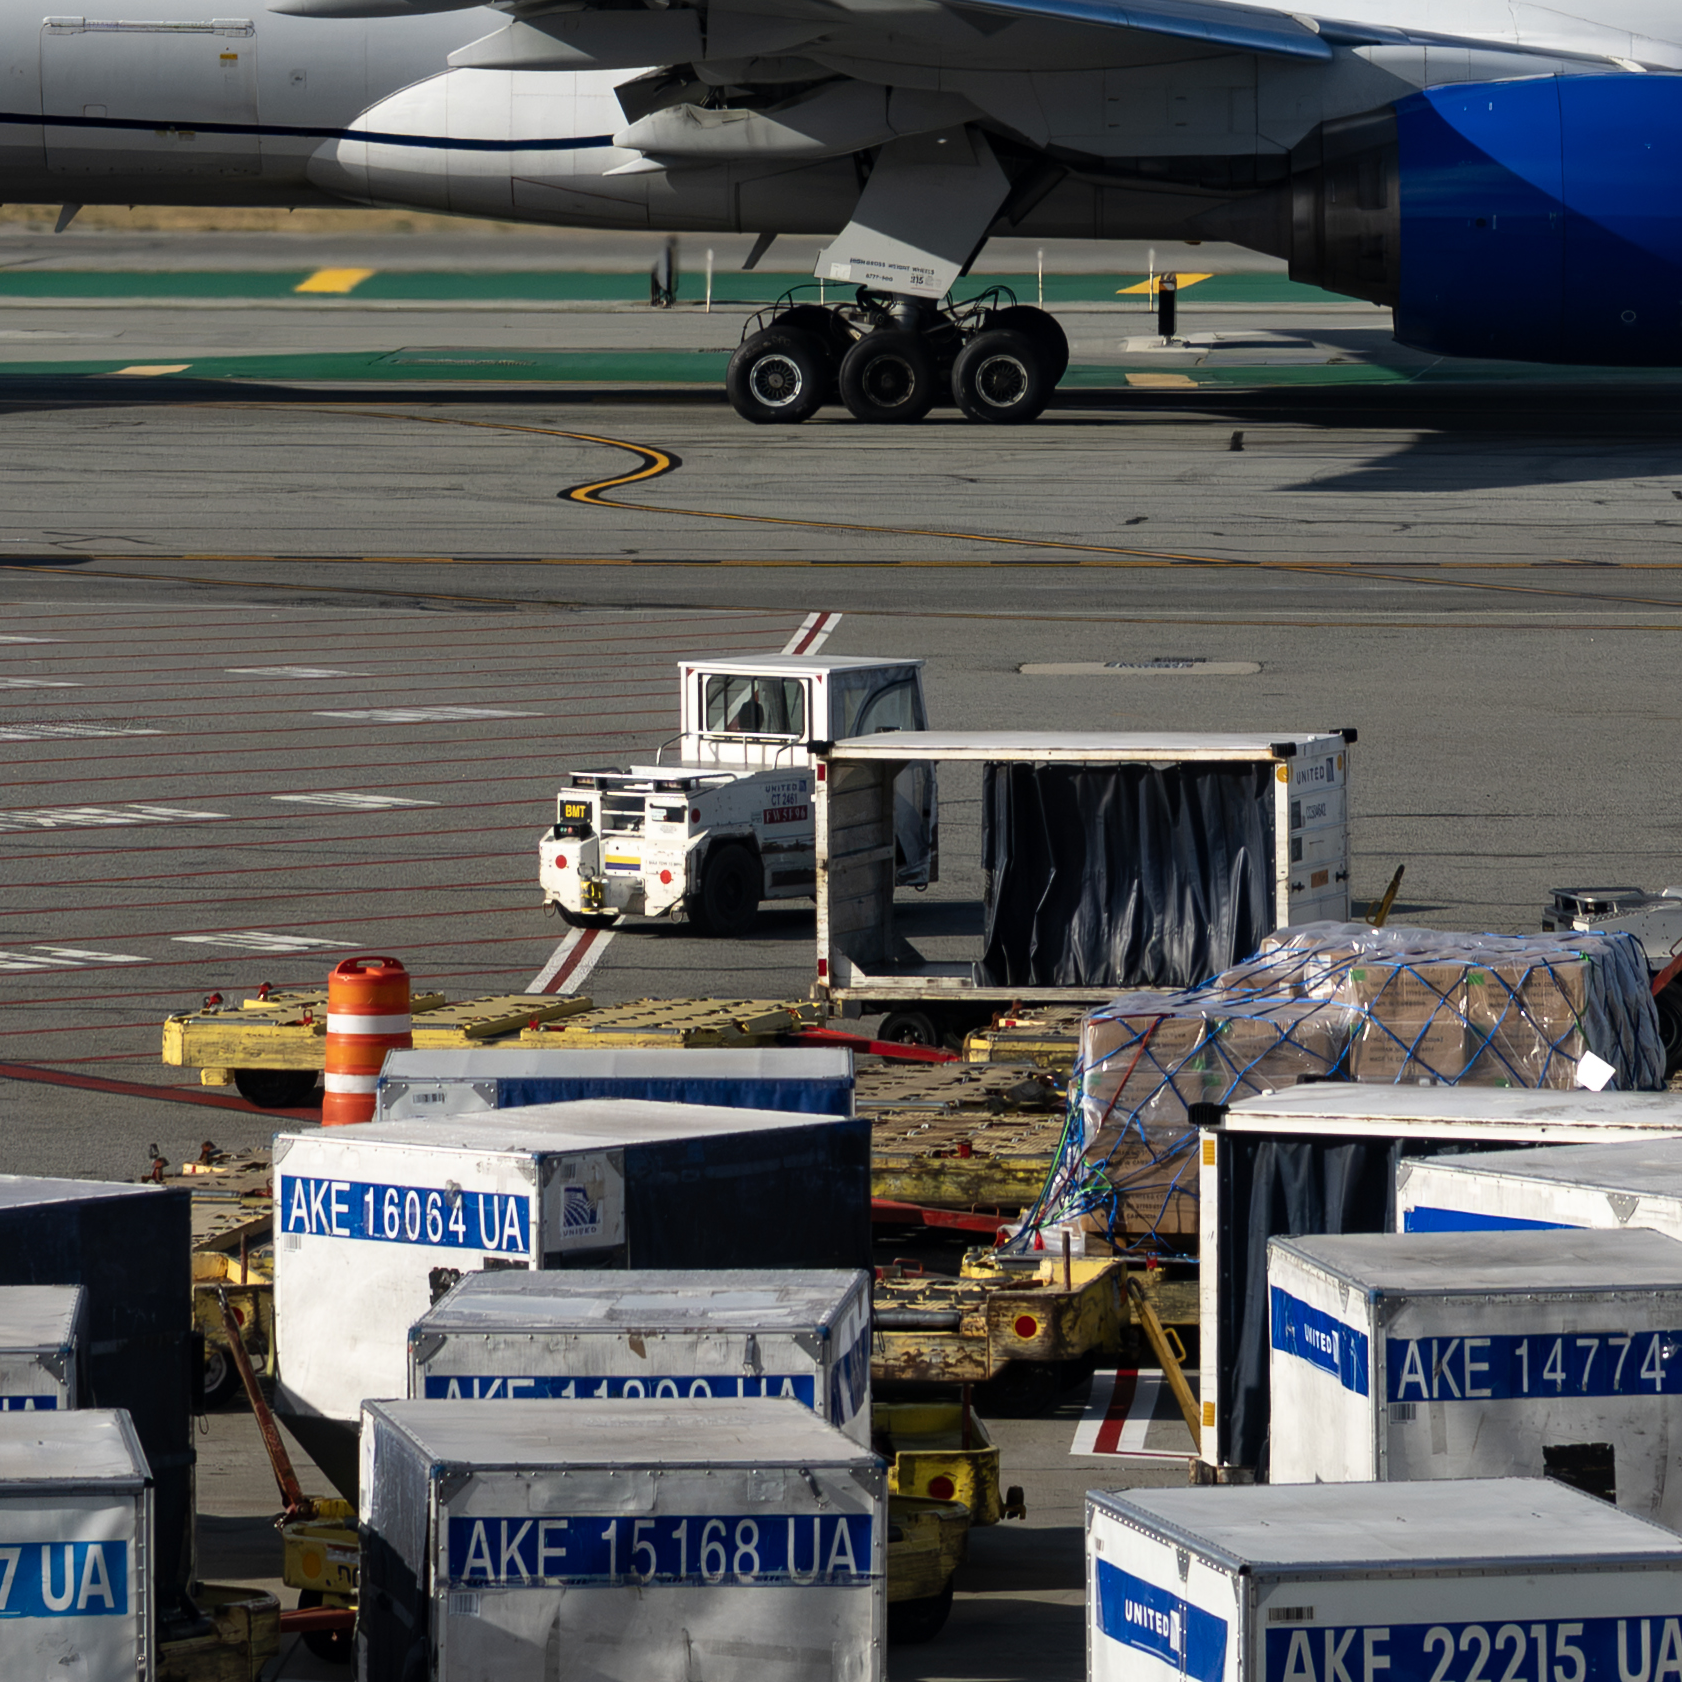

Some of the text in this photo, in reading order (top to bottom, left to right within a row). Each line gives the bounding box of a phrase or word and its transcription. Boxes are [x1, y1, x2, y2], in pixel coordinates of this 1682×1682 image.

[765, 783, 798, 793] UNITED
[1296, 766, 1325, 785] UNITED
[565, 804, 586, 819] BMT
[771, 794, 781, 806] CT
[289, 1178, 524, 1252] AKE 16064 UA
[1304, 1323, 1333, 1354] UNITED
[1398, 1338, 1492, 1400] AKE
[1515, 1333, 1666, 1393] 14774
[600, 1518, 760, 1584] 15168
[787, 1517, 858, 1585] UA
[41, 1543, 115, 1612] UA
[1124, 1598, 1171, 1637] UNITED
[1282, 1627, 1391, 1682] AKE
[1423, 1621, 1587, 1682] 22215
